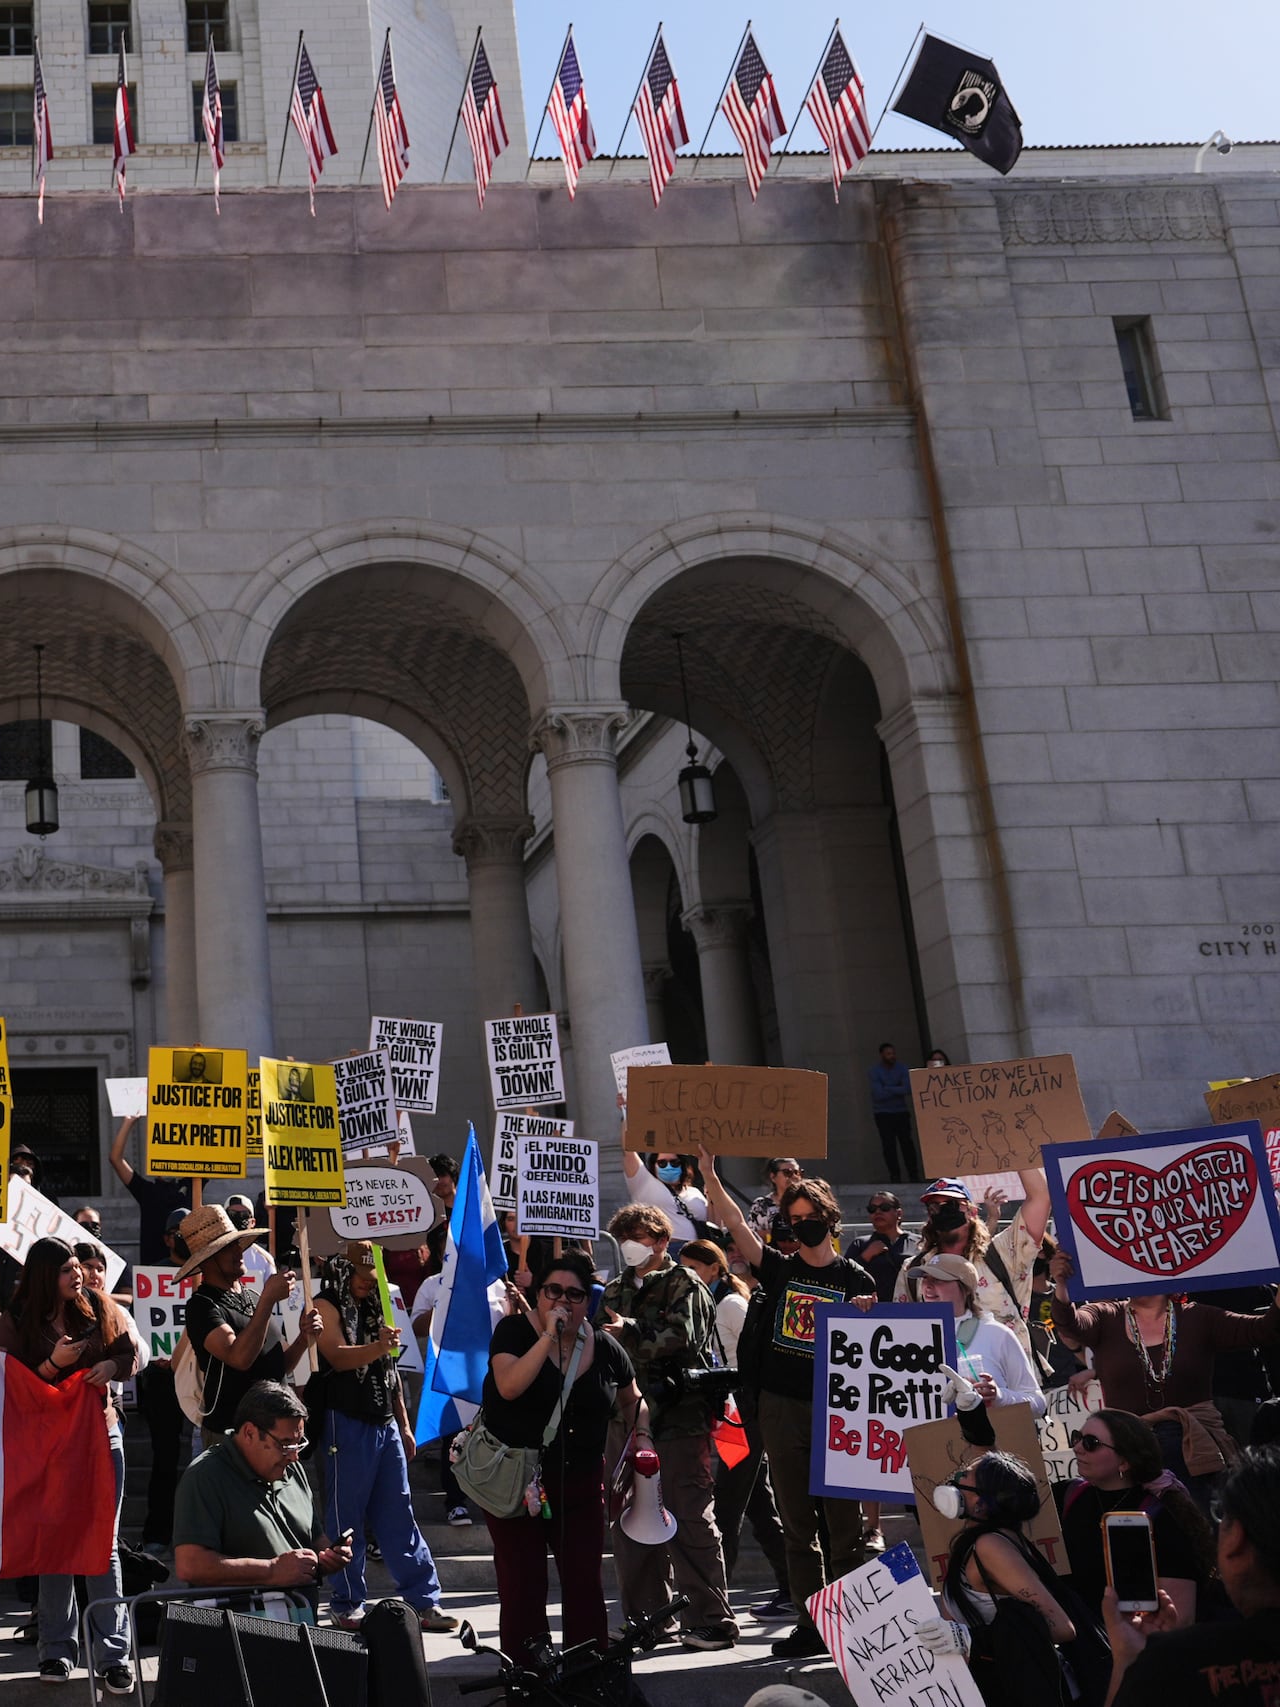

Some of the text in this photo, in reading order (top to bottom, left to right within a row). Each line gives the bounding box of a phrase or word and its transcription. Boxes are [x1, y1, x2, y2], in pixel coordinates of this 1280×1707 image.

[1241, 924, 1274, 936] 200
[1199, 941, 1250, 957] CITY
[378, 1020, 436, 1039] THE WHOLE
[491, 1017, 550, 1036] THE WHOLE
[375, 1034, 436, 1048] SYSTEM
[491, 1032, 552, 1045] SYSTEM
[391, 1044, 434, 1065] GUILTY
[494, 1041, 552, 1062] IS GUILTY
[350, 1054, 383, 1076] WHOLE
[495, 1060, 555, 1075] SHUT IT
[500, 1070, 555, 1096] DOWN!
[924, 1062, 1049, 1092] MAKE ORWELL
[152, 1084, 242, 1108] JUSTICE FOR
[344, 1078, 385, 1104] GUILTY
[647, 1079, 689, 1113] ICE
[693, 1080, 752, 1109] OUT
[760, 1081, 797, 1113] OF
[920, 1073, 1063, 1109] FICTION AGAIN
[266, 1102, 335, 1129] JUSTICE FOR
[152, 1123, 241, 1148] ALEX PRETTI
[666, 1117, 796, 1145] EVERYWHERE
[268, 1145, 338, 1172] ALEX PRETTI
[524, 1141, 592, 1155] ¡EL PUEBLO
[152, 1161, 240, 1174] PARTY FOR SOCIALISM & LIBERATION
[530, 1153, 586, 1173] UNIDO
[365, 1179, 399, 1190] NEVER
[401, 1178, 409, 1189] A
[526, 1170, 590, 1185] DEFENDERÁ
[1078, 1169, 1126, 1206] ICE
[1153, 1171, 1181, 1201] NO
[380, 1194, 415, 1206] JUST
[522, 1190, 595, 1209] A LAS FAMILIAS
[342, 1206, 422, 1227] TO EXIST!
[526, 1205, 591, 1223] INMIGRANTES
[1084, 1177, 1251, 1249] FOR OUR WARM
[1129, 1219, 1224, 1271] HEARTS
[830, 1323, 944, 1374] Be Good
[828, 1373, 943, 1420] Be Pretti
[828, 1414, 862, 1456] Be
[823, 1568, 895, 1632] MAKE
[868, 1644, 937, 1704] AFRAID
